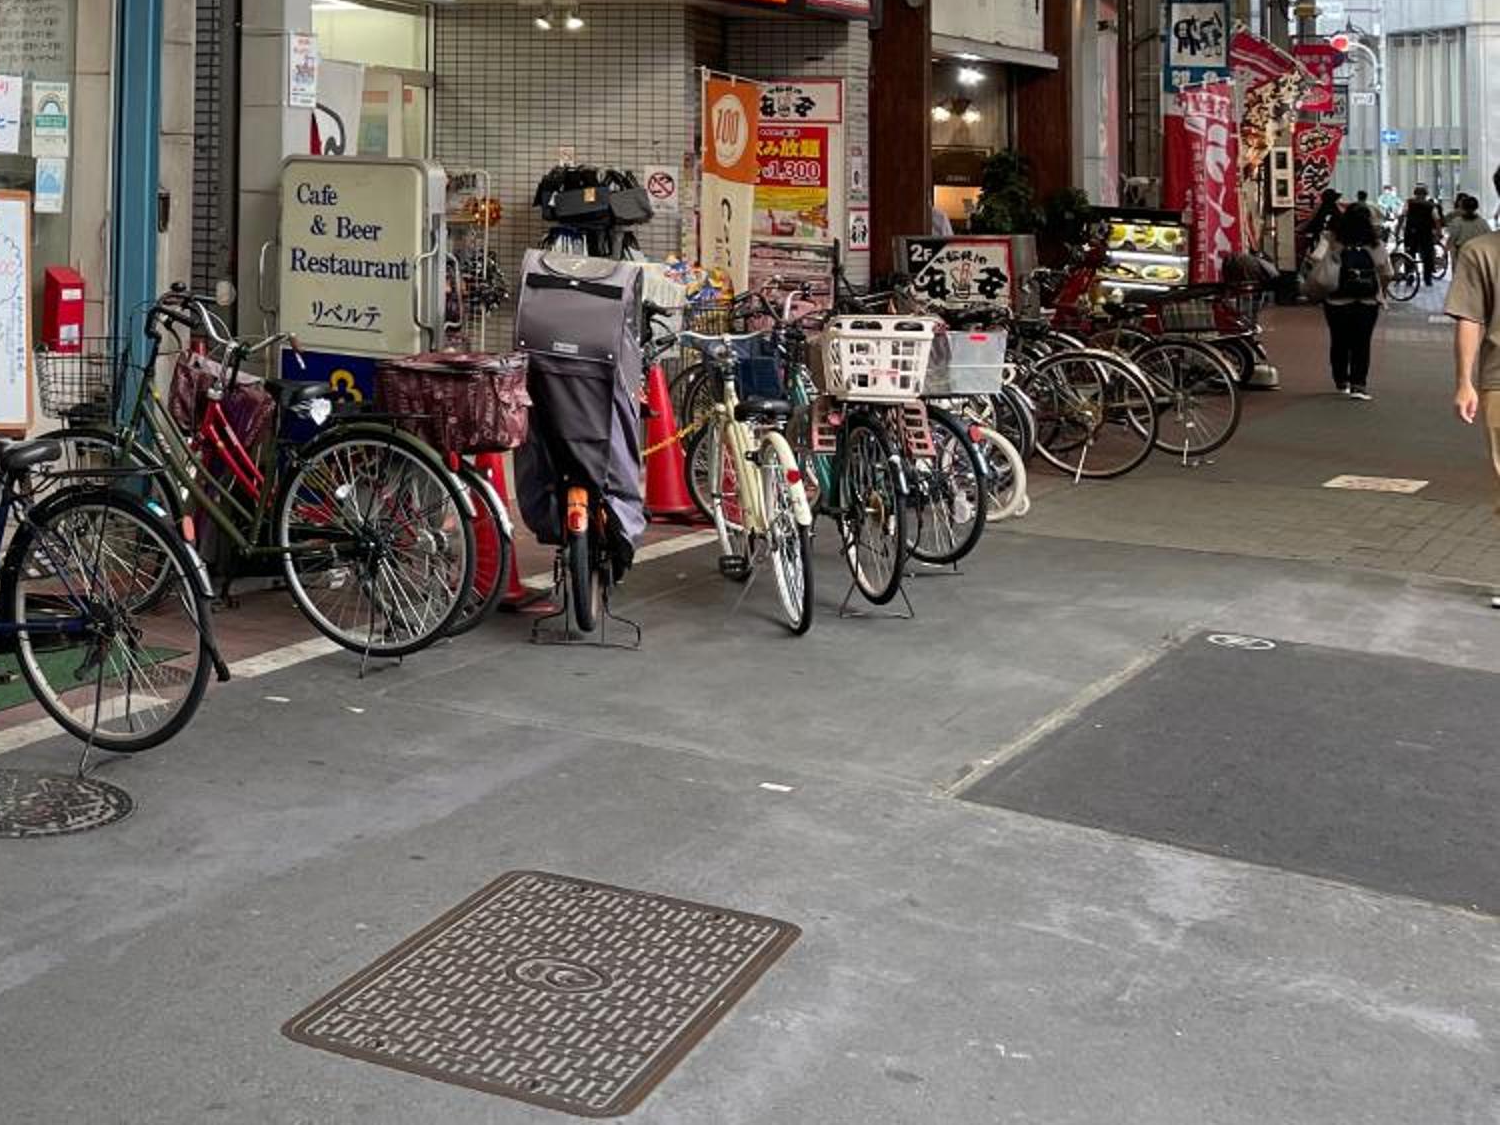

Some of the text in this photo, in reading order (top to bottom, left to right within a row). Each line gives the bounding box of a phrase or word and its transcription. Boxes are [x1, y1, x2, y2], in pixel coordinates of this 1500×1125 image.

[297, 182, 338, 206] Cafe
[310, 214, 382, 241] & Beer
[290, 247, 410, 281] Restaurant
[910, 243, 932, 262] 2F
[312, 300, 382, 328] リベルテ
